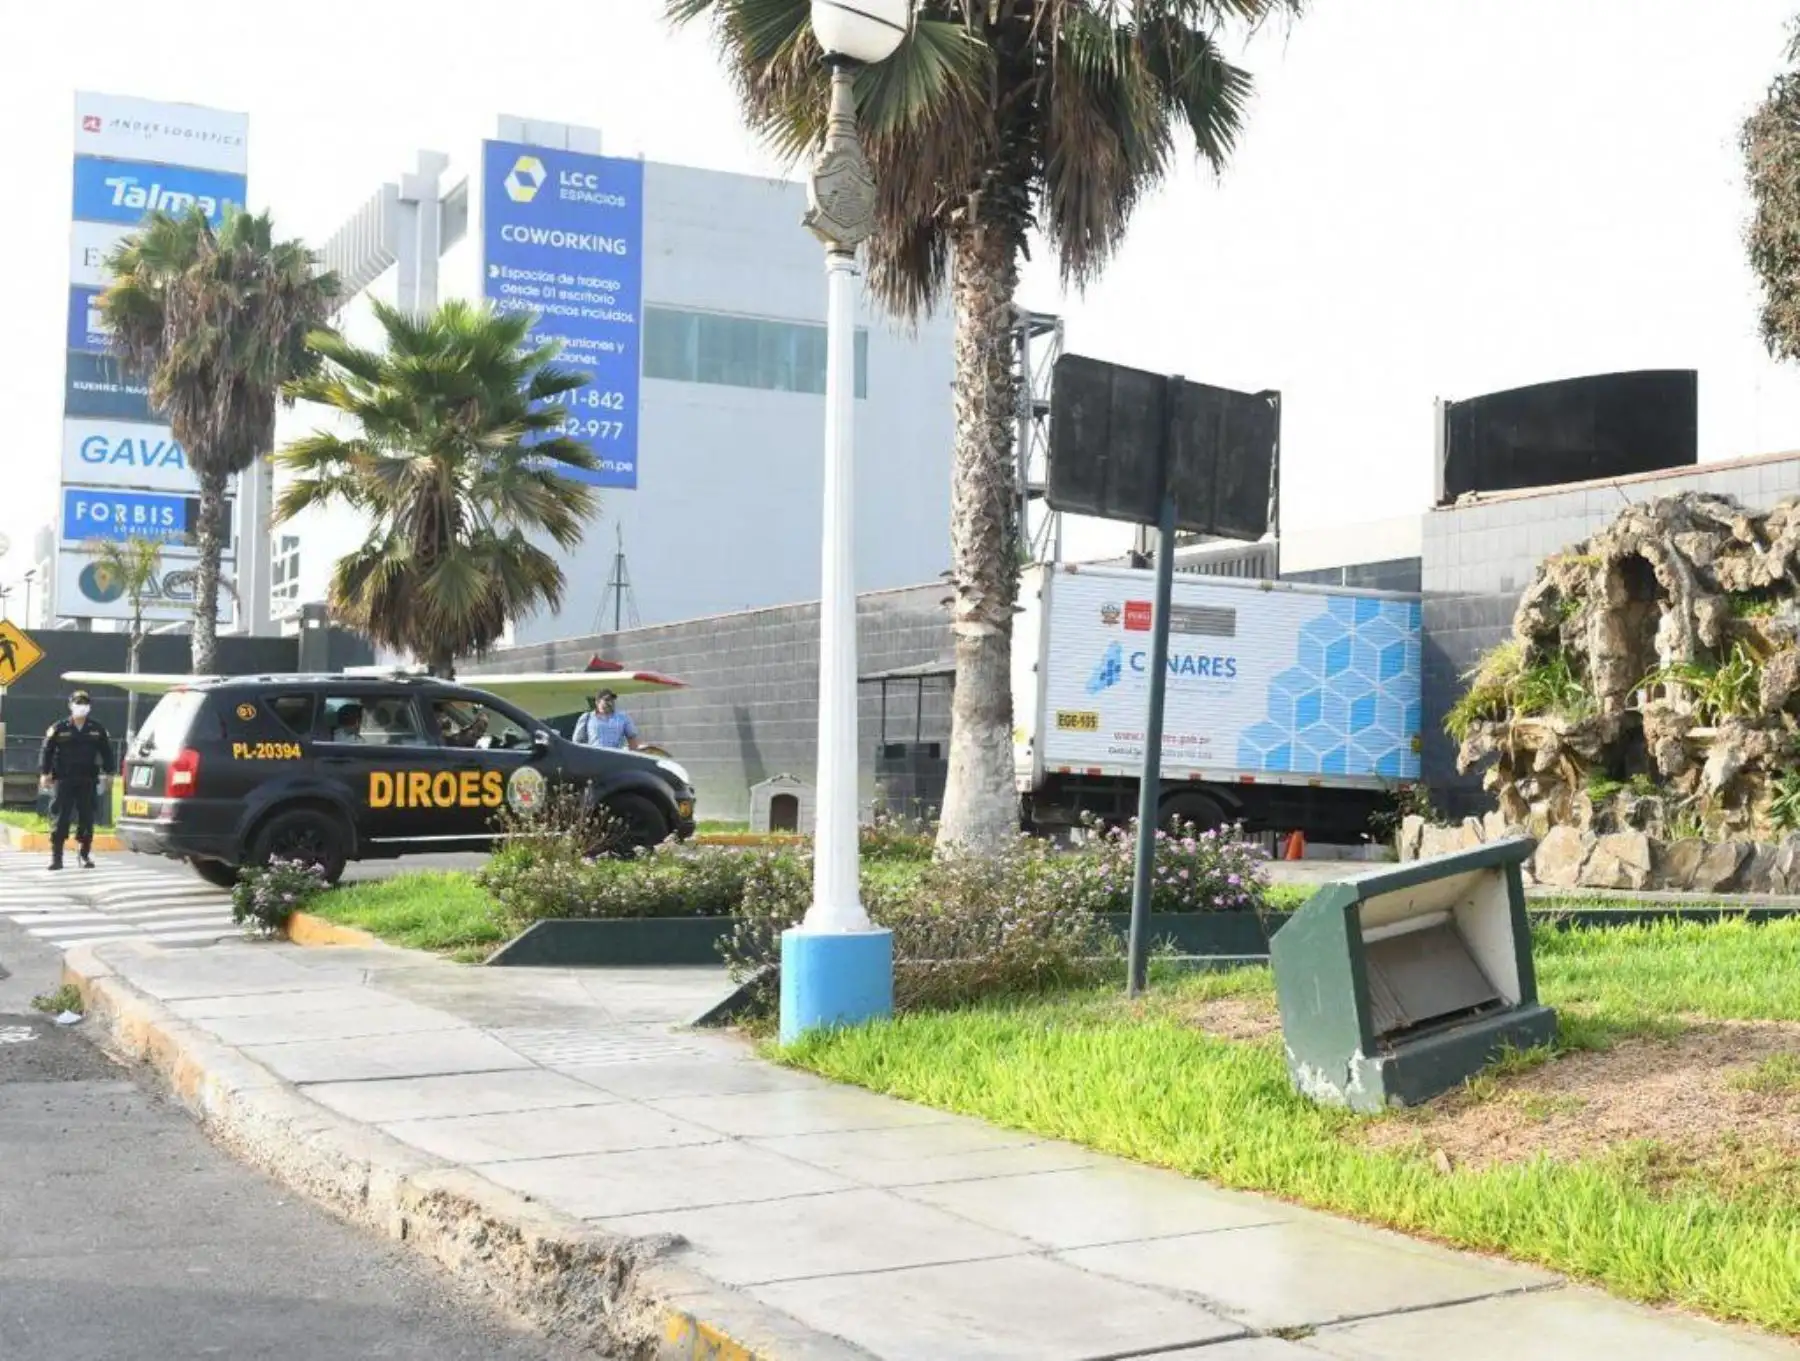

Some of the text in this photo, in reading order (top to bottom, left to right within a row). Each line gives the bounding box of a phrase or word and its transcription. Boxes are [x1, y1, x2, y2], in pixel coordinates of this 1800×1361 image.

[559, 170, 599, 189] LCC
[105, 175, 216, 217] Talma
[559, 188, 627, 208] ESPACIOS
[500, 224, 627, 256] COWORKING
[501, 266, 621, 292] Espacios de trabajo
[500, 283, 616, 306] desde 01 escritorio
[616, 341, 626, 355] y
[80, 434, 185, 470] GAVA
[75, 501, 175, 527] FORBIS
[1130, 651, 1237, 679] CNARES
[232, 742, 302, 760] PL-20394
[369, 771, 504, 808] DIROES
